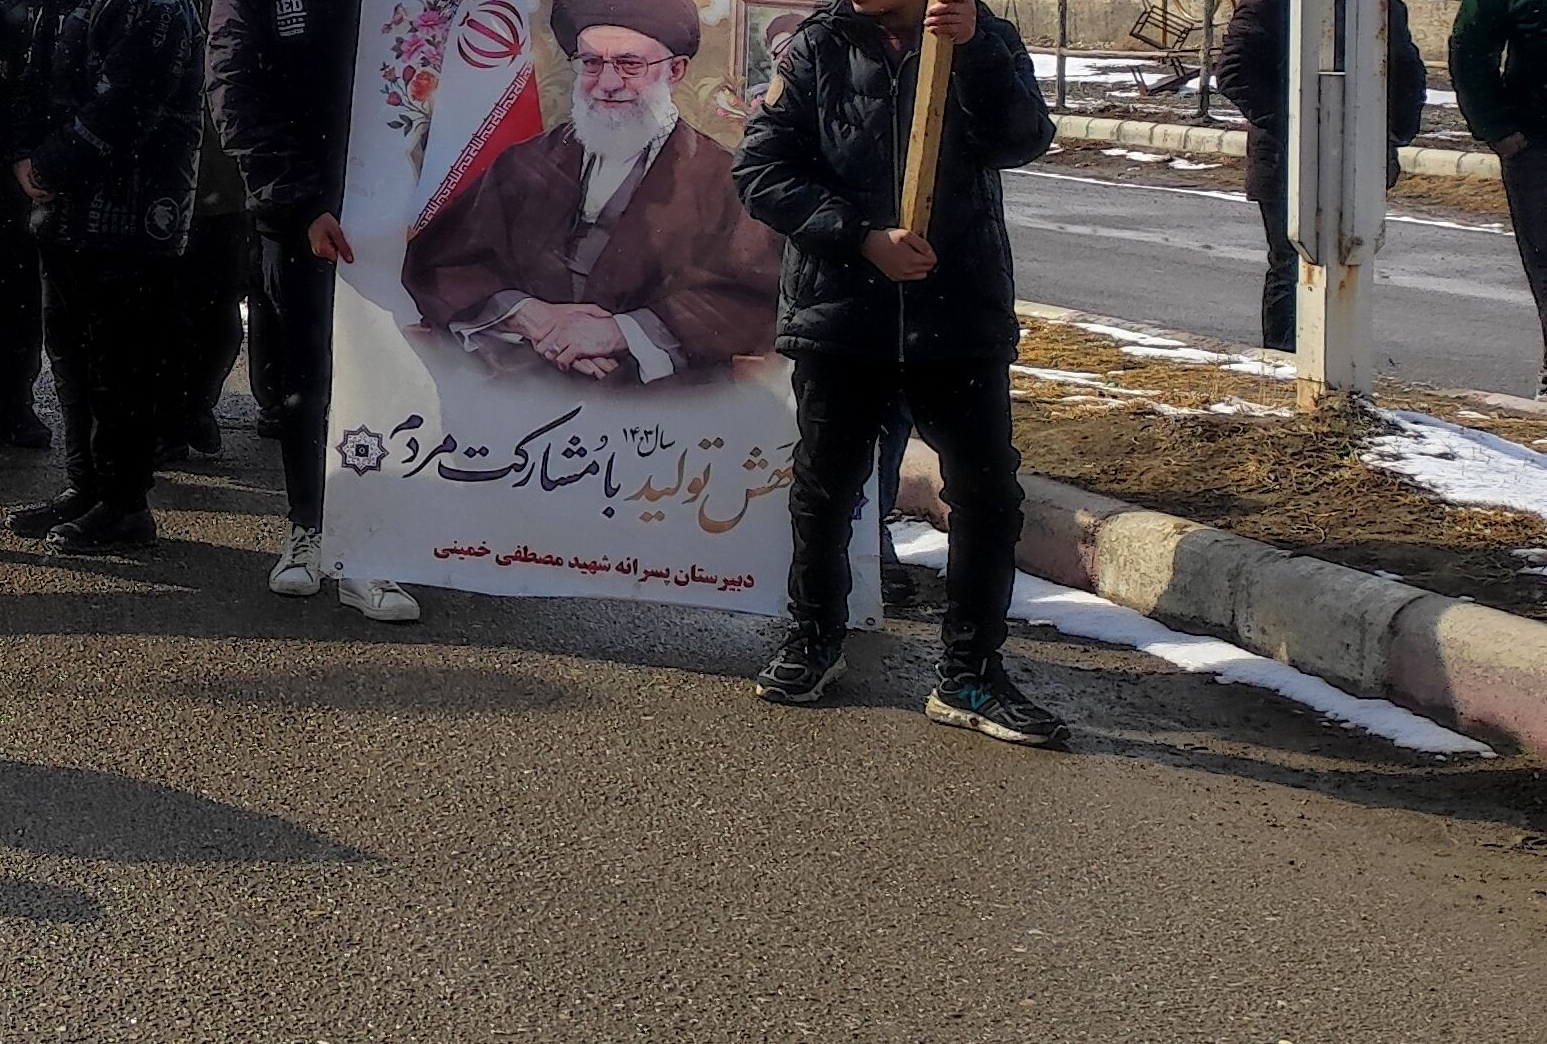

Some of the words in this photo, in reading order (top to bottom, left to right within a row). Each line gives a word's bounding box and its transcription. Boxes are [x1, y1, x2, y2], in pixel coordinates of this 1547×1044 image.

[389, 413, 459, 479] مردم
[638, 422, 676, 457] سال
[600, 451, 622, 519] با
[624, 437, 725, 523] تولید
[432, 539, 492, 560] خمینی
[494, 544, 564, 568] مصطفی
[567, 554, 612, 575] شهید
[614, 558, 672, 588] پسرانه
[674, 561, 756, 592] دبیرستان
